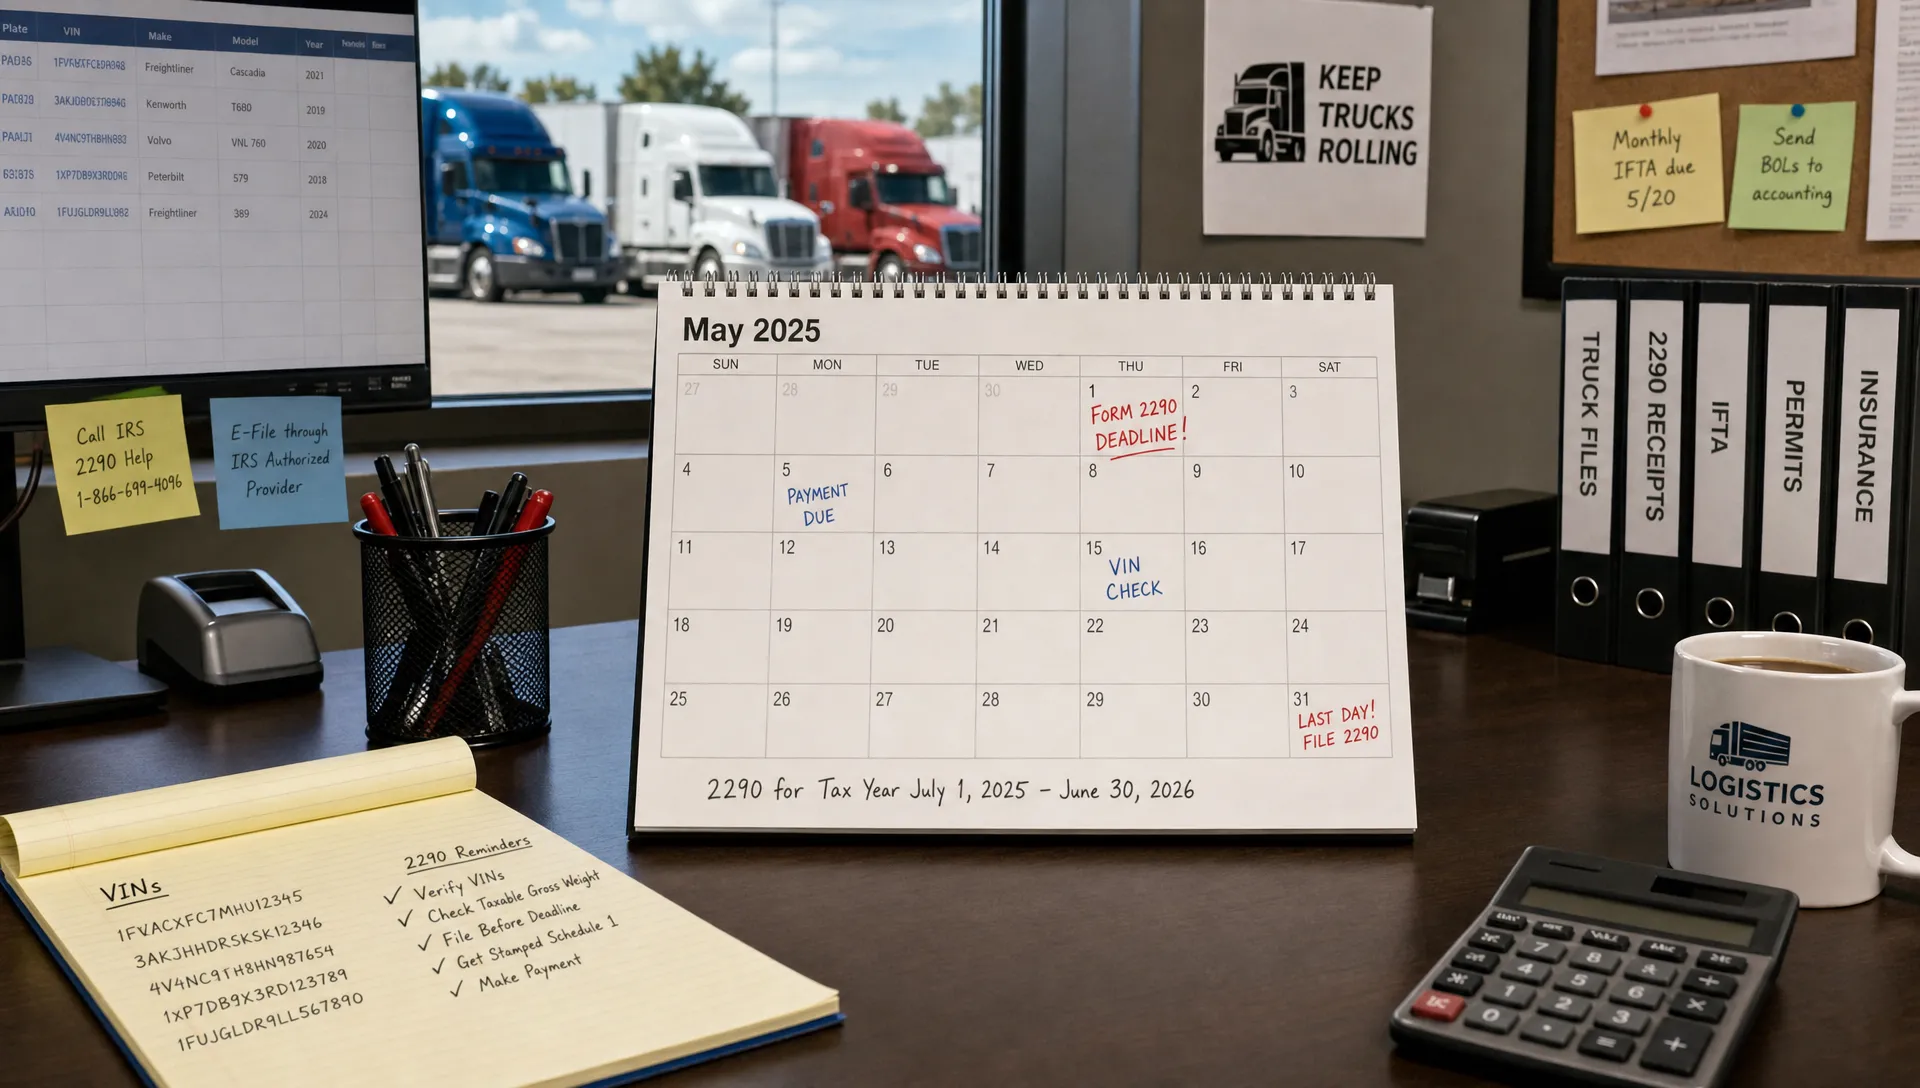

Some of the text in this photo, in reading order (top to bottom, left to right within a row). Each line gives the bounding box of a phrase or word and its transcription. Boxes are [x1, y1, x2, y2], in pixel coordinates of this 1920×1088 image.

[3, 24, 27, 33] Plate
[64, 27, 80, 36] VIN
[149, 32, 172, 41] Make
[233, 36, 258, 45] Model
[306, 40, 323, 48] Year
[146, 62, 193, 74] Freightliner
[230, 67, 265, 77] Cascadia
[306, 71, 323, 80] 2021
[1320, 65, 1381, 91] KEEP
[147, 100, 186, 109] Kenworth
[231, 103, 252, 112] T680
[307, 106, 325, 115] 2019
[1319, 103, 1414, 130] TRUCKS
[147, 136, 171, 145] Volvo
[232, 138, 266, 147] VNL 760
[307, 141, 326, 149] 2020
[1613, 128, 1680, 153] Monthly
[1774, 127, 1815, 145] Send
[1319, 138, 1417, 165] ROLLING
[1614, 158, 1695, 180] IFTA due
[1762, 156, 1822, 173] BOLs to
[148, 172, 184, 181] Peterbilt
[234, 174, 248, 182] 579
[308, 175, 327, 184] 2018
[1628, 186, 1675, 212] 5/20
[1753, 185, 1832, 208] accounting
[149, 208, 196, 219] Freightliner
[234, 209, 249, 218] 389
[310, 210, 328, 218] 2024
[684, 317, 820, 347] May 2025
[713, 359, 1340, 372] SUN MON TUE WED THU FRI SAT
[684, 382, 1298, 398] 27 28 29 30 1 2 3
[1140, 399, 1177, 417] 2290
[1580, 332, 1600, 496] TRUCK FILES
[77, 420, 144, 445] Call IRS
[232, 423, 328, 444] E-File through
[1095, 415, 1187, 452] DEADLINE!
[1646, 331, 1667, 521] 2290 RECEIPTS
[1711, 402, 1729, 453] IFTA
[1784, 380, 1805, 492] PERMITS
[1856, 371, 1878, 522] INSURANCE
[76, 448, 153, 475] 2290 Help
[232, 451, 329, 469] IRS Authorized
[682, 462, 1305, 478] 4 5 6 7 8 9 10
[77, 471, 182, 508] 1-866-699-4096
[247, 479, 302, 497] Provider
[788, 483, 848, 504] PAYMENT
[804, 508, 834, 526] DUE
[678, 540, 1306, 555] 11 12 13 14 15 16 17
[1109, 556, 1140, 575] VIN
[1107, 581, 1163, 600] CHECK
[673, 617, 1309, 633] 18 19 20 21 22 23 24
[669, 691, 1309, 707] 25 26 27 28 29 30 31
[1299, 699, 1374, 729] LAST DAY!
[1304, 726, 1378, 750] FILE 2290
[708, 779, 762, 800] 2290
[774, 777, 804, 800] for
[818, 777, 851, 799] Tax
[863, 778, 900, 800] Year
[910, 778, 945, 807] July
[958, 779, 970, 803] 1,
[982, 780, 1029, 799] 2025
[1060, 779, 1099, 799] June
[1110, 779, 1139, 803] 30,
[1151, 780, 1194, 798] 2026
[1690, 765, 1825, 806] LOGISTICS
[1689, 793, 1820, 827] SOLUTIONS
[404, 836, 531, 869] 2290 Reminders
[100, 878, 163, 902] VINs
[414, 870, 505, 900] Verify VINs
[428, 870, 601, 923] Check Taxable Gross Weight
[443, 902, 580, 947] File Before Deadline
[457, 914, 619, 969] Get Stamped Schedule 1
[1534, 942, 1602, 963] 7 8
[479, 953, 582, 992] Make Payment
[1517, 963, 1645, 999] 4 5 6
[1504, 985, 1630, 1024] 1 2 3
[1482, 1008, 1500, 1021] 0
